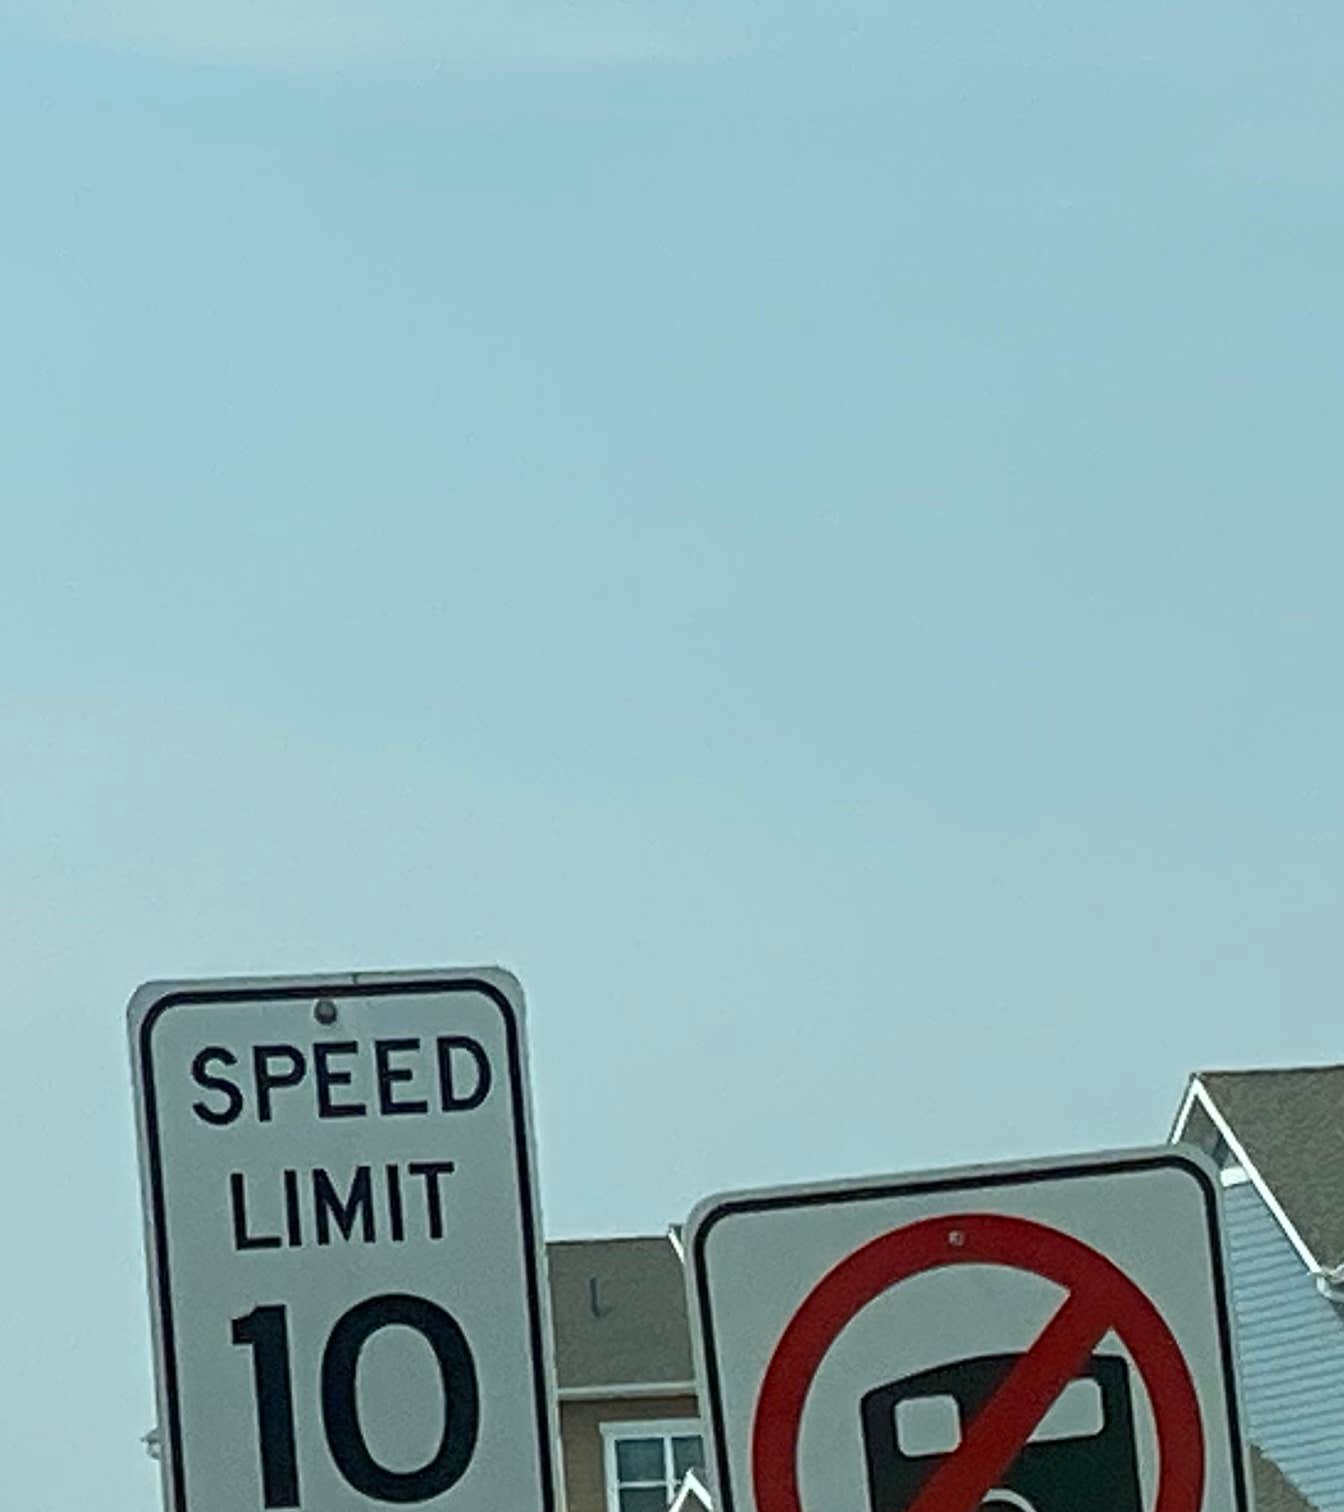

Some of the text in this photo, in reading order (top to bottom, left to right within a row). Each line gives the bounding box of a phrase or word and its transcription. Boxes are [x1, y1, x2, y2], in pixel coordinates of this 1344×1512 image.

[192, 1036, 492, 1126] SPEED
[231, 1161, 455, 1251] LIMIT
[231, 1293, 479, 1510] 10
